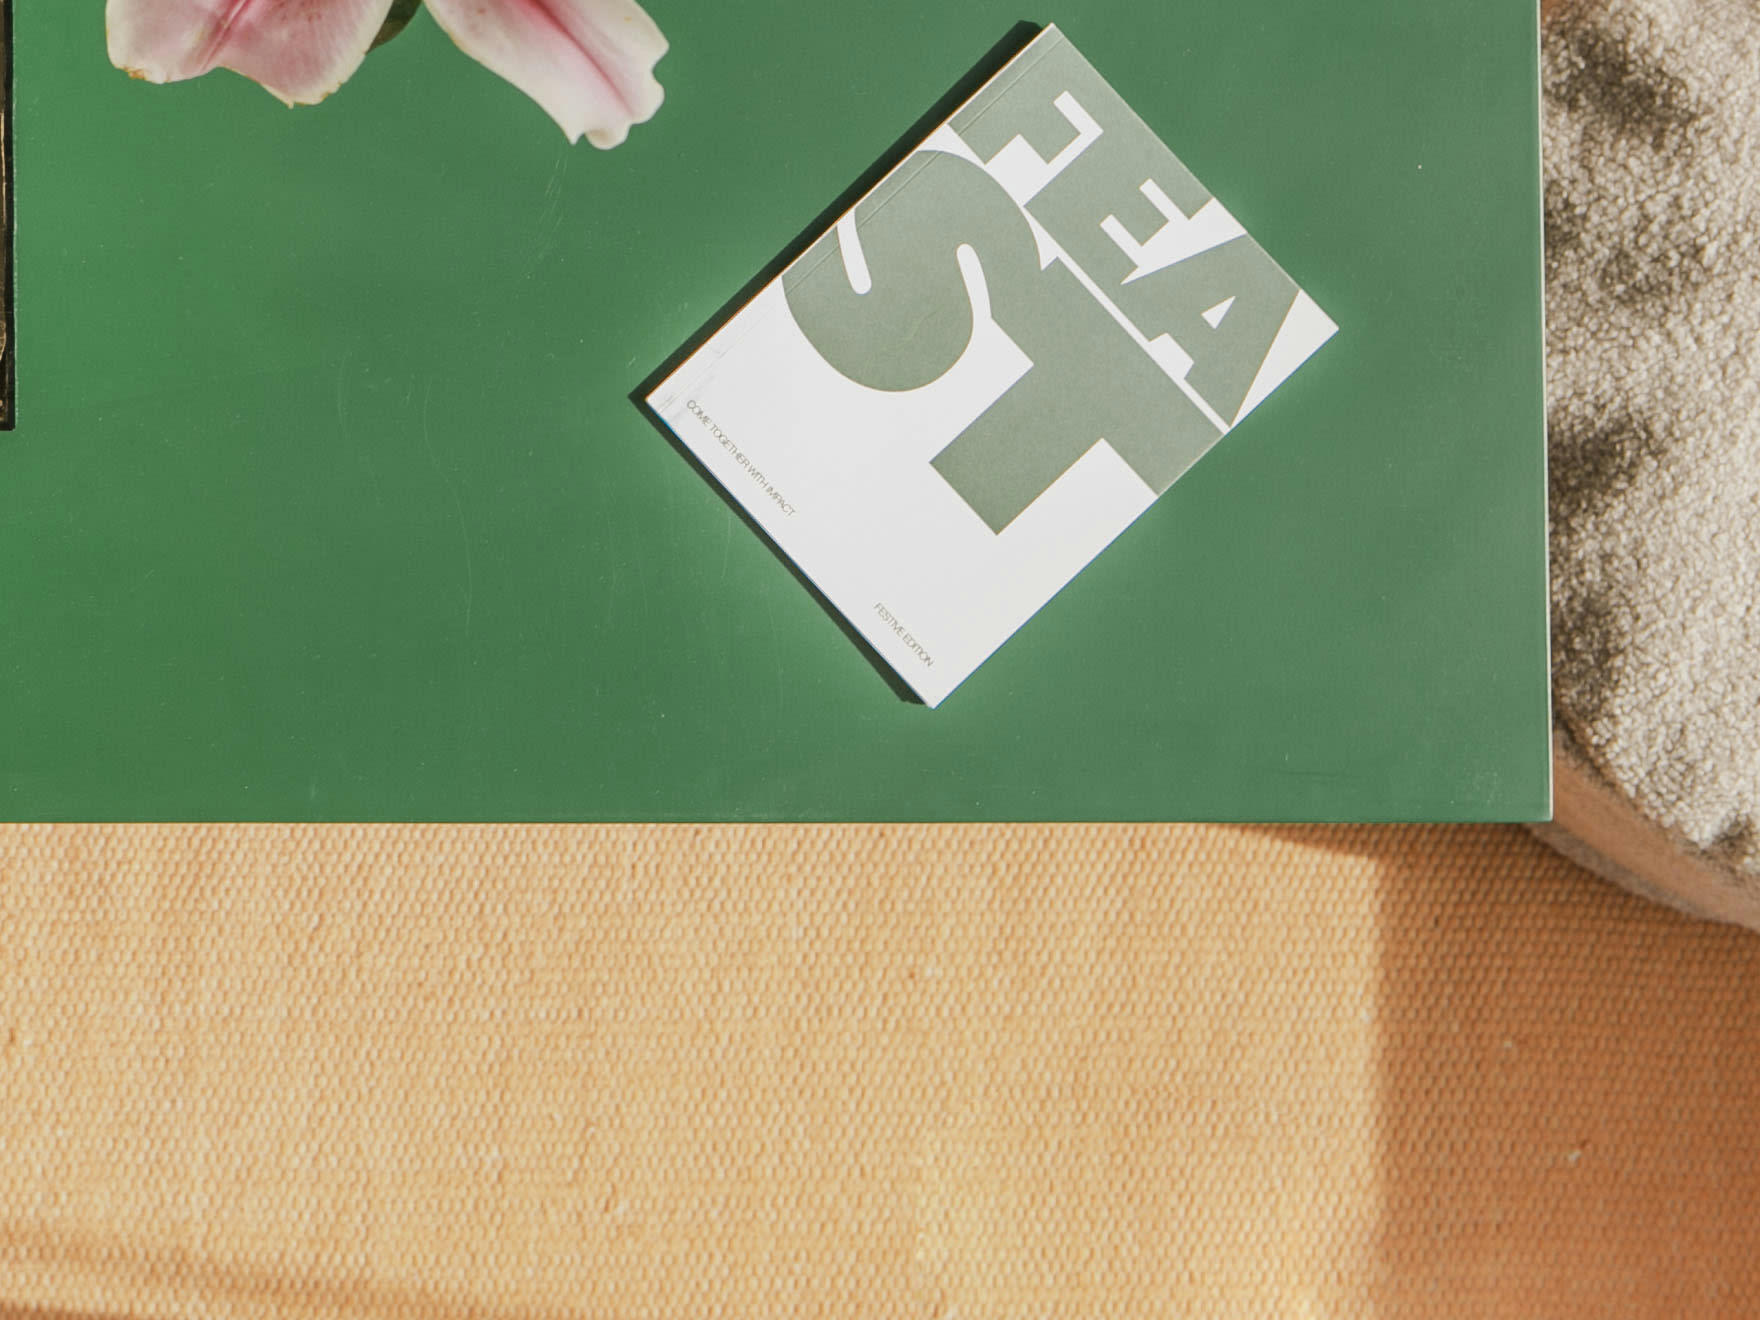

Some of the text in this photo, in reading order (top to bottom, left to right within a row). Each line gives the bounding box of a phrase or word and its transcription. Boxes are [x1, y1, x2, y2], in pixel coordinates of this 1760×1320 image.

[686, 399, 796, 517] COME TOGETHER WITH IMPACT
[873, 602, 934, 667] FESTIVE EDITION
